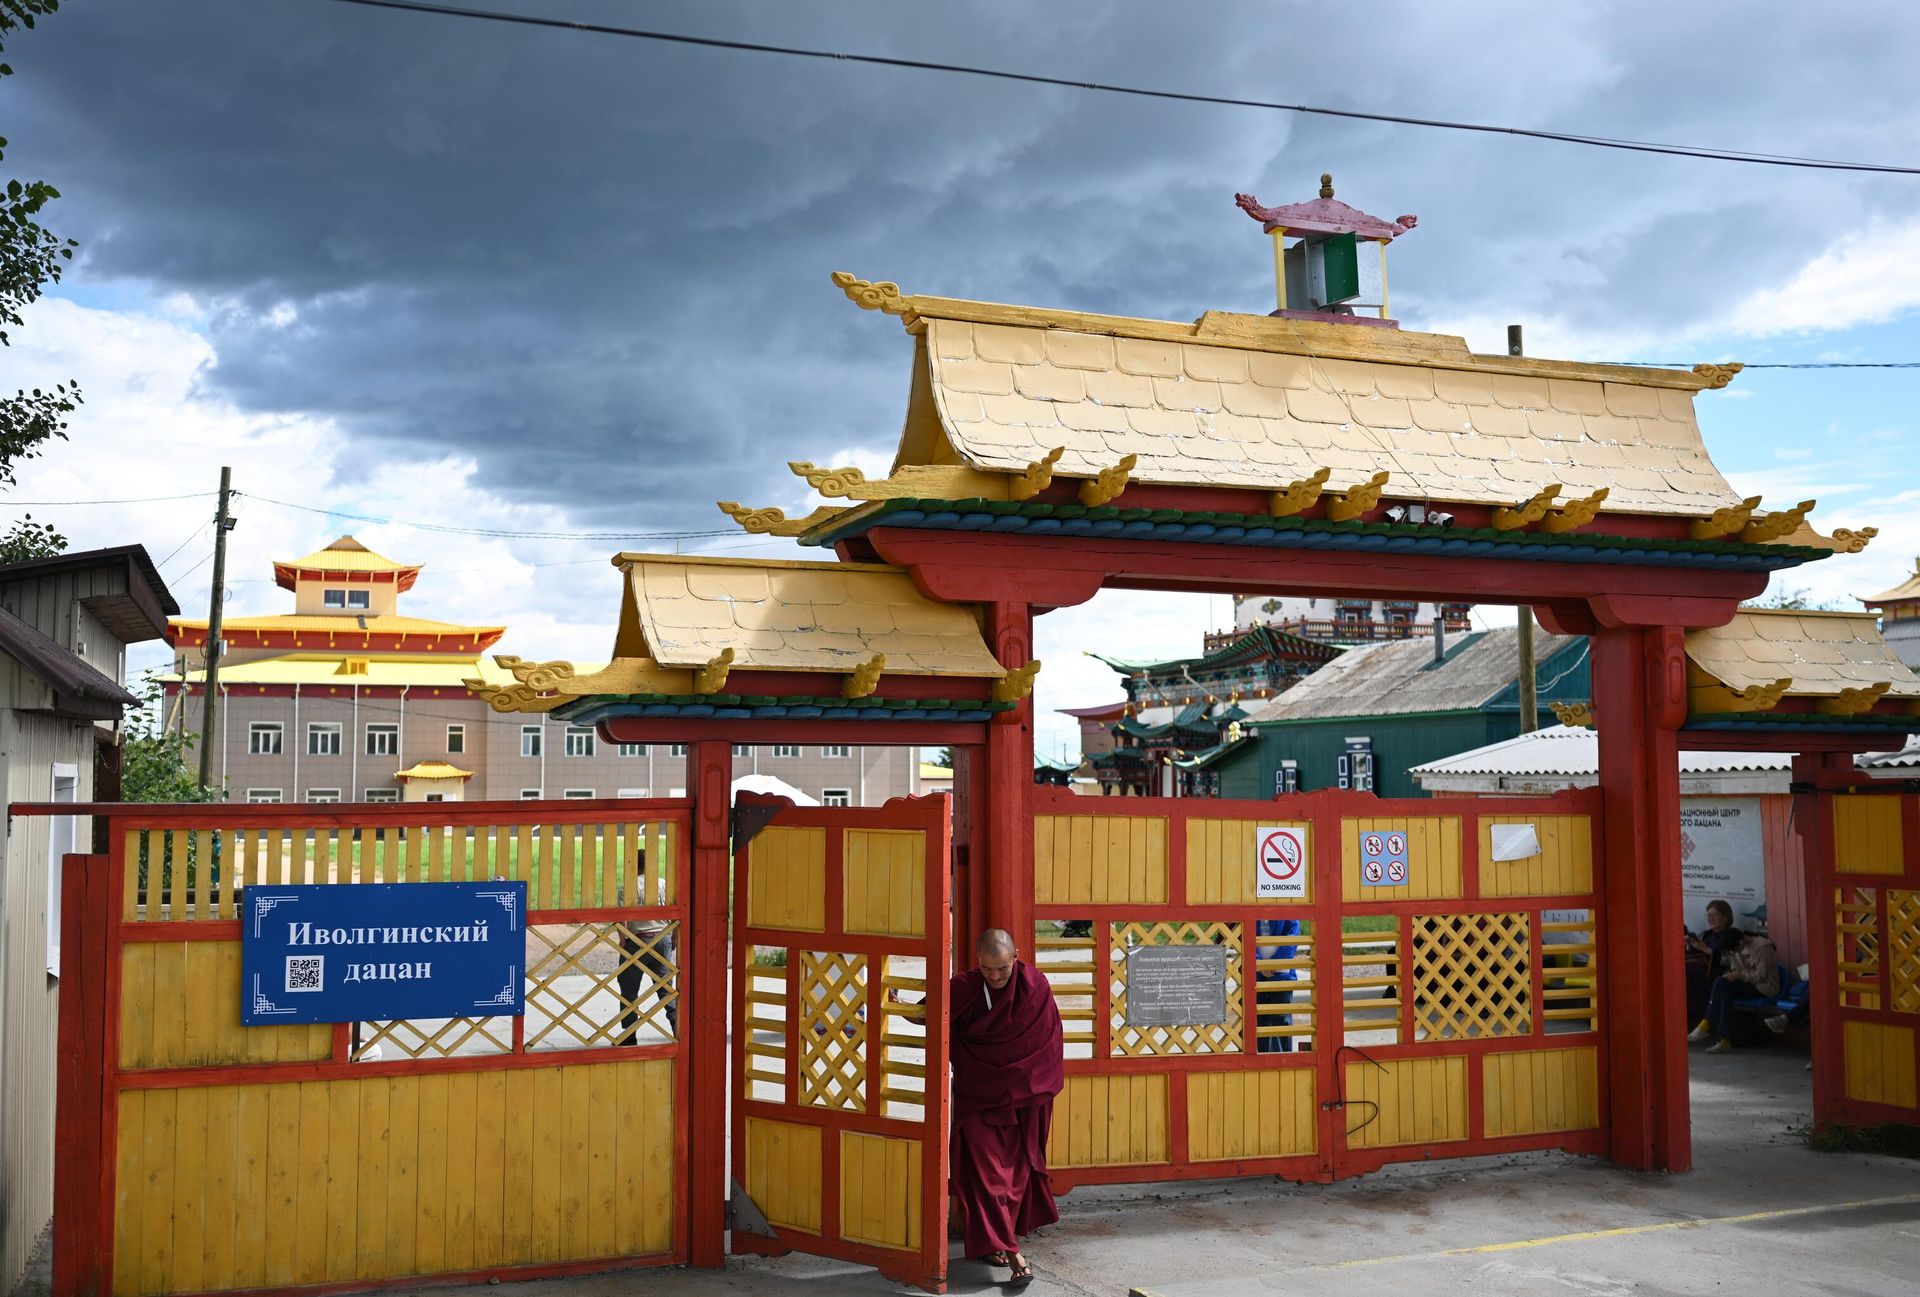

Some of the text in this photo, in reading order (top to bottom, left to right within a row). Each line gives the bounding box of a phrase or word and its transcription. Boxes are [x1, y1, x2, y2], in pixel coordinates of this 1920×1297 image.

[1720, 808, 1741, 817] ЦЕНТР
[1694, 819, 1722, 828] ДАЦАНА
[286, 919, 489, 946] Иволгинский
[343, 961, 433, 984] дацан
